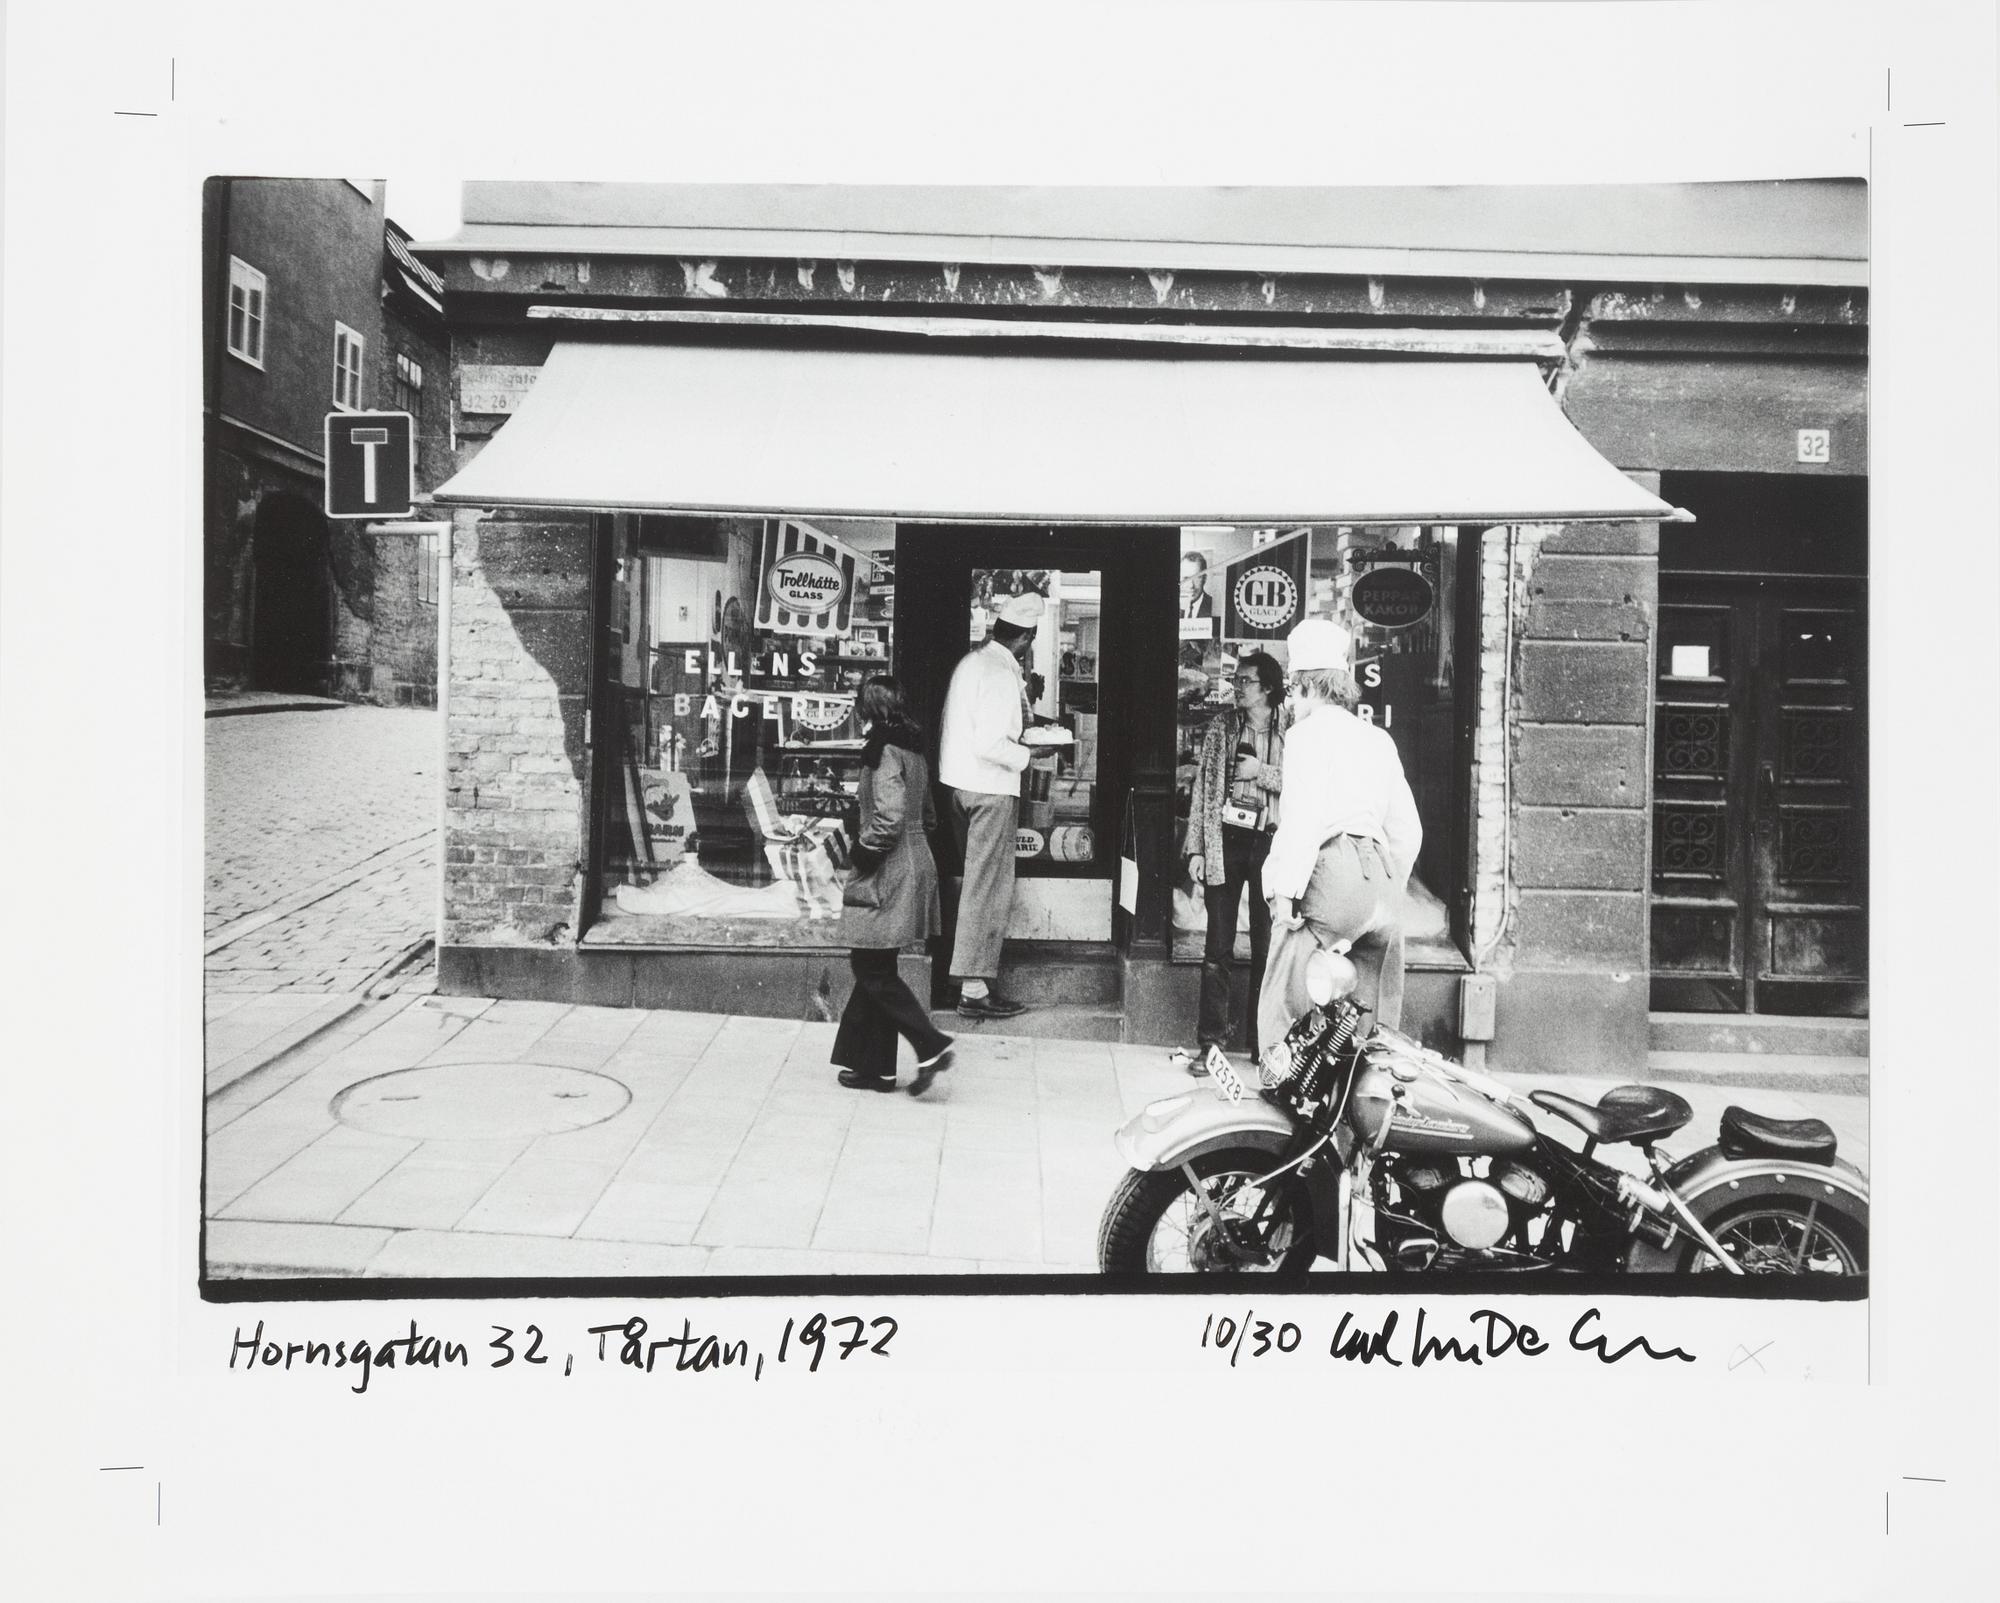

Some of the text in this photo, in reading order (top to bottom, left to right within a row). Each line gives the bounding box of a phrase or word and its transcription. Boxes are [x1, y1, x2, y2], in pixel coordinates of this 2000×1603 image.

[1803, 436, 1825, 457] 32
[777, 568, 840, 591] Trollhätte
[789, 590, 823, 600] GLASS
[1245, 580, 1287, 607] GB
[1249, 607, 1280, 616] GLACE
[1363, 602, 1419, 615] KAKOR
[684, 649, 817, 677] ELLENS
[1015, 843, 1039, 852] ARIE
[1016, 836, 1035, 844] ULD
[1201, 1309, 1302, 1368] 10/30
[229, 1319, 468, 1394] Hornsgatan
[777, 1312, 899, 1373] 1972
